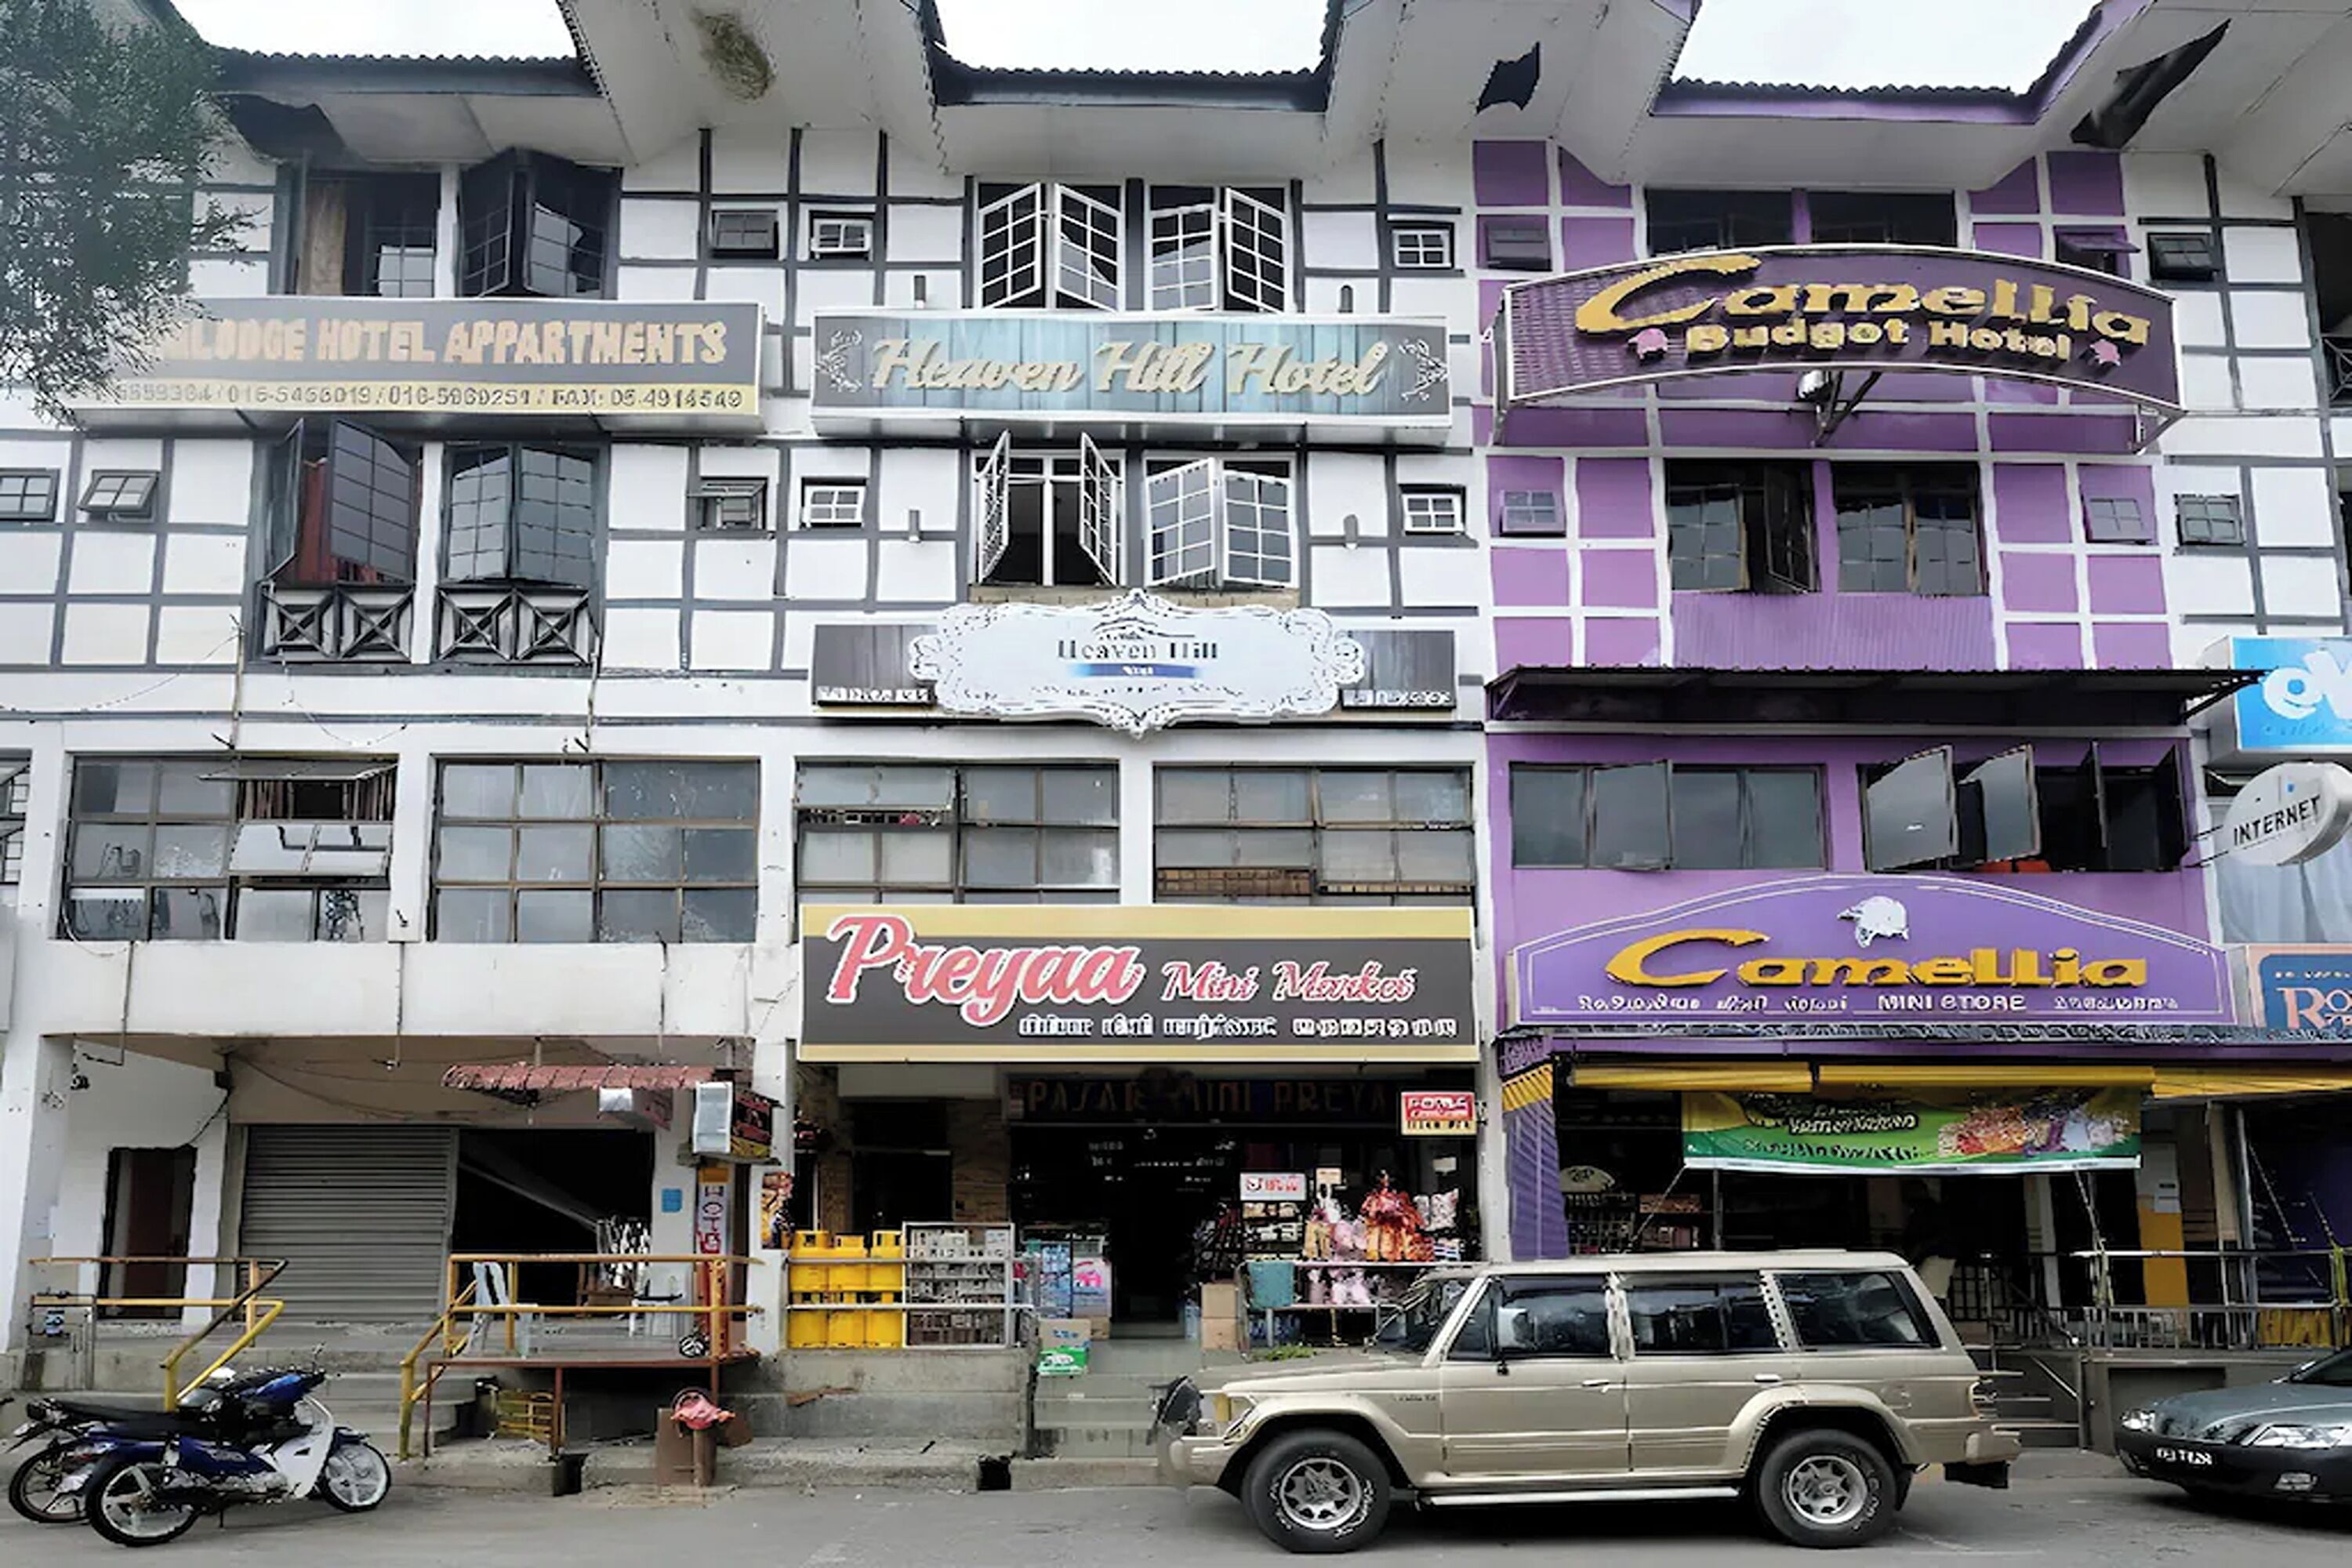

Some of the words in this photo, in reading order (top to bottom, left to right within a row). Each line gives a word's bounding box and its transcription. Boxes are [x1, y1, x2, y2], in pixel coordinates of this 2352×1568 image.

[1575, 254, 2152, 345] Camellia
[317, 318, 437, 364] HOTEL
[443, 320, 728, 365] APPARTMENTS
[871, 338, 1085, 393] Heaven
[1095, 341, 1215, 394] Hill
[1225, 341, 1390, 396] Hotel
[1058, 639, 1157, 659] Heaven
[2234, 794, 2321, 846] INTERNET
[826, 914, 1145, 1027] Preyaa
[1160, 960, 1260, 1003] Mini
[1605, 928, 2148, 988] Camellia
[1878, 994, 1933, 1011] MINI
[1940, 994, 2027, 1011] STORE
